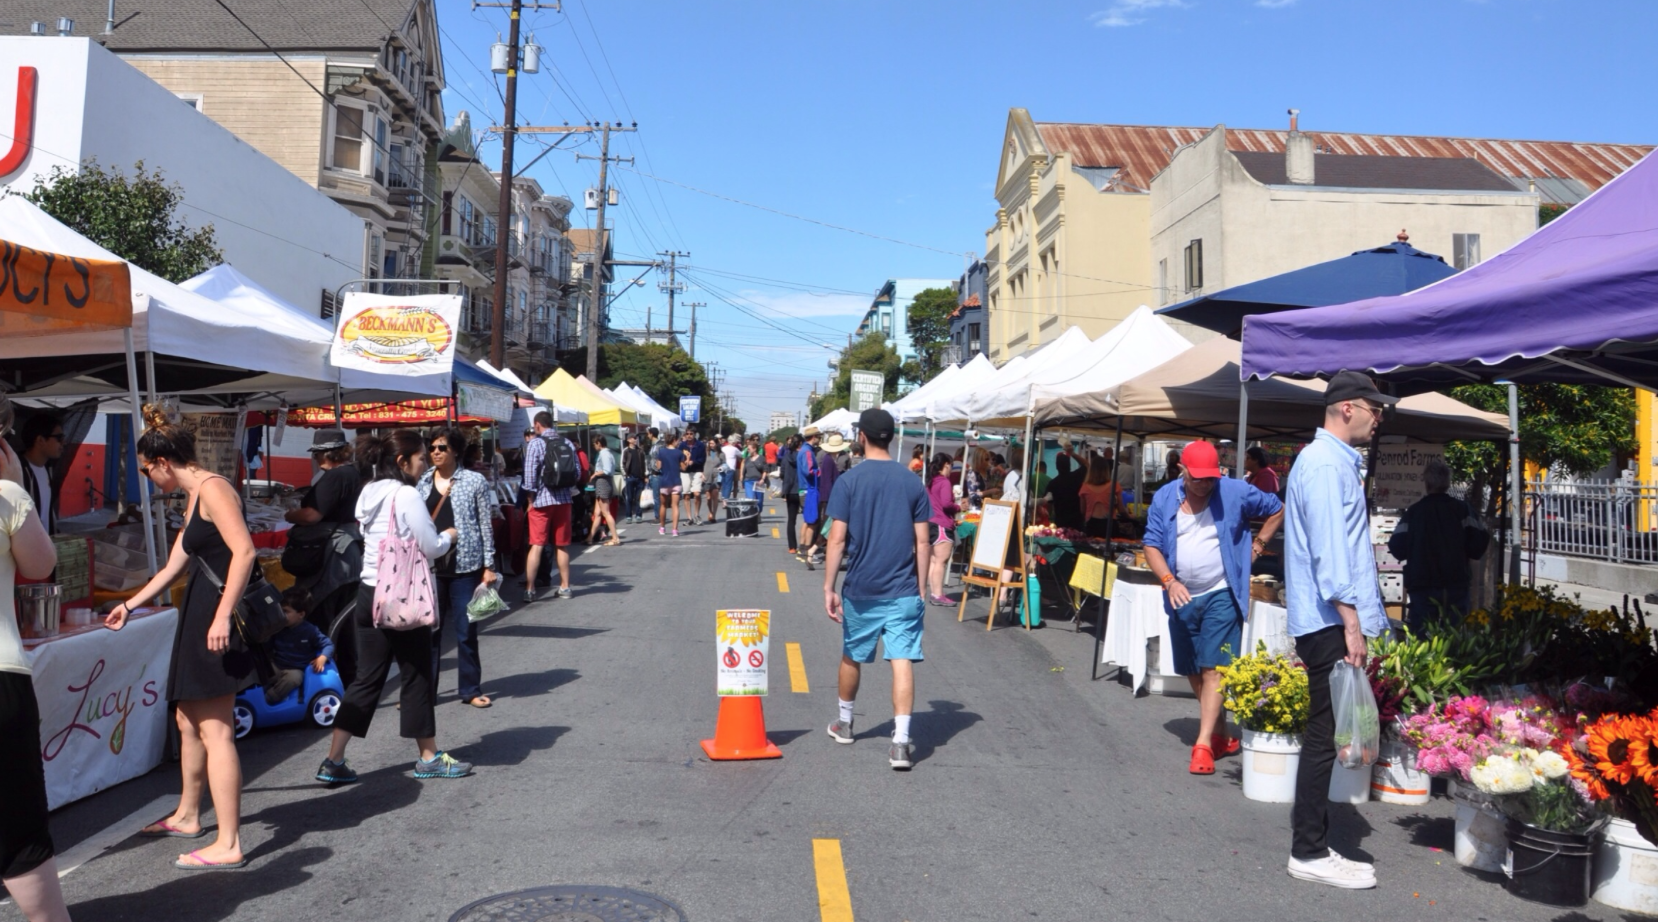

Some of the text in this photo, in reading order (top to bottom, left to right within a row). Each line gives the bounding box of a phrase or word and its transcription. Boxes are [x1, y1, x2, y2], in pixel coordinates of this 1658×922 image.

[358, 315, 437, 333] BECKMANN'S
[854, 383, 879, 393] ORGANIC
[859, 392, 873, 402] SOLD
[343, 411, 357, 420] CA
[358, 411, 371, 419] Tel
[378, 410, 394, 419] 831
[401, 410, 418, 418] 475
[425, 409, 447, 418] 3240
[200, 415, 222, 428] HOME
[1376, 449, 1442, 466] Penrod Farms
[42, 659, 158, 762] Lucy's
